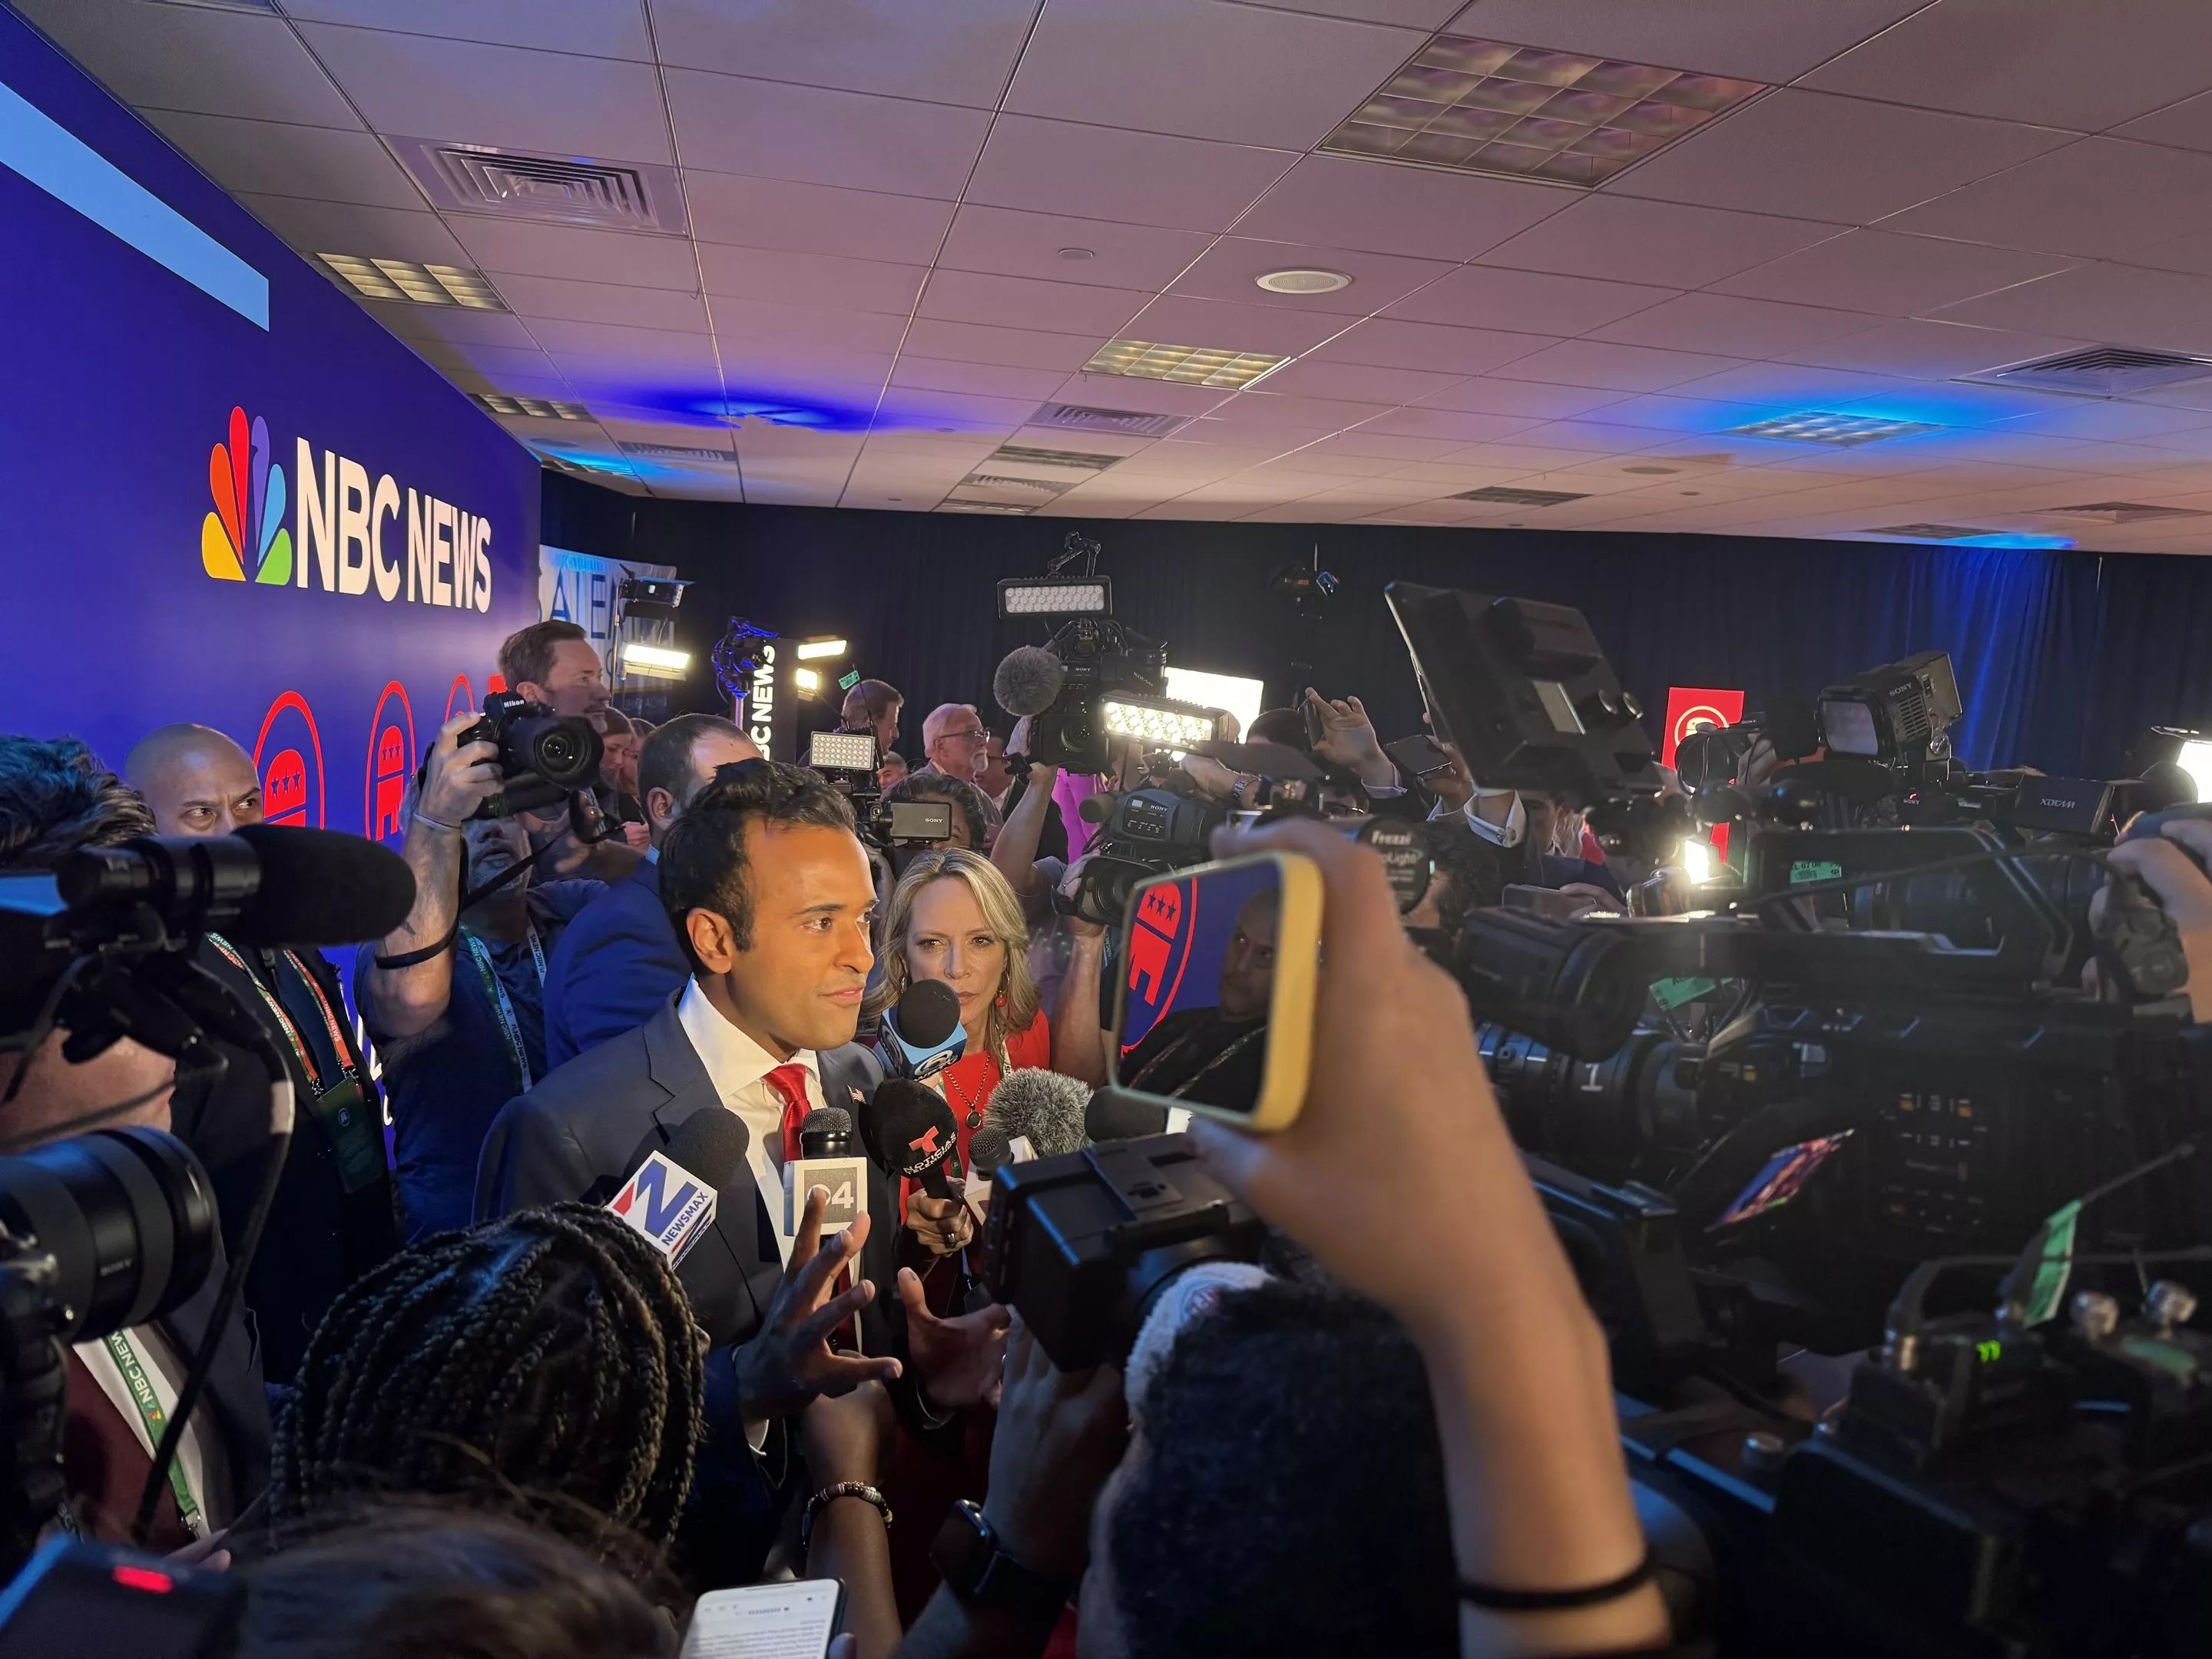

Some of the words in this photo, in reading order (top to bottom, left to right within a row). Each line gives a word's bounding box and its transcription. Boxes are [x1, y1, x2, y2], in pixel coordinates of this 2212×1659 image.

[296, 435, 401, 602] NBC
[407, 487, 492, 614] NEWS
[752, 645, 776, 722] NEWS
[1889, 682, 1912, 697] SONY
[503, 700, 525, 708] Nikon
[2039, 798, 2075, 809] XDCAM
[1371, 830, 1412, 845] Frezzi
[530, 933, 540, 952] NEWS
[535, 952, 545, 967] NBC
[265, 996, 281, 1018] NEWS
[278, 1017, 290, 1035] NBC
[330, 1020, 340, 1042] NEWS
[513, 1031, 524, 1046] NBC
[518, 1047, 528, 1068] NEWS
[661, 1191, 709, 1247] NEWSMAX
[111, 1330, 135, 1366] NEW
[128, 1366, 154, 1403] NBC
